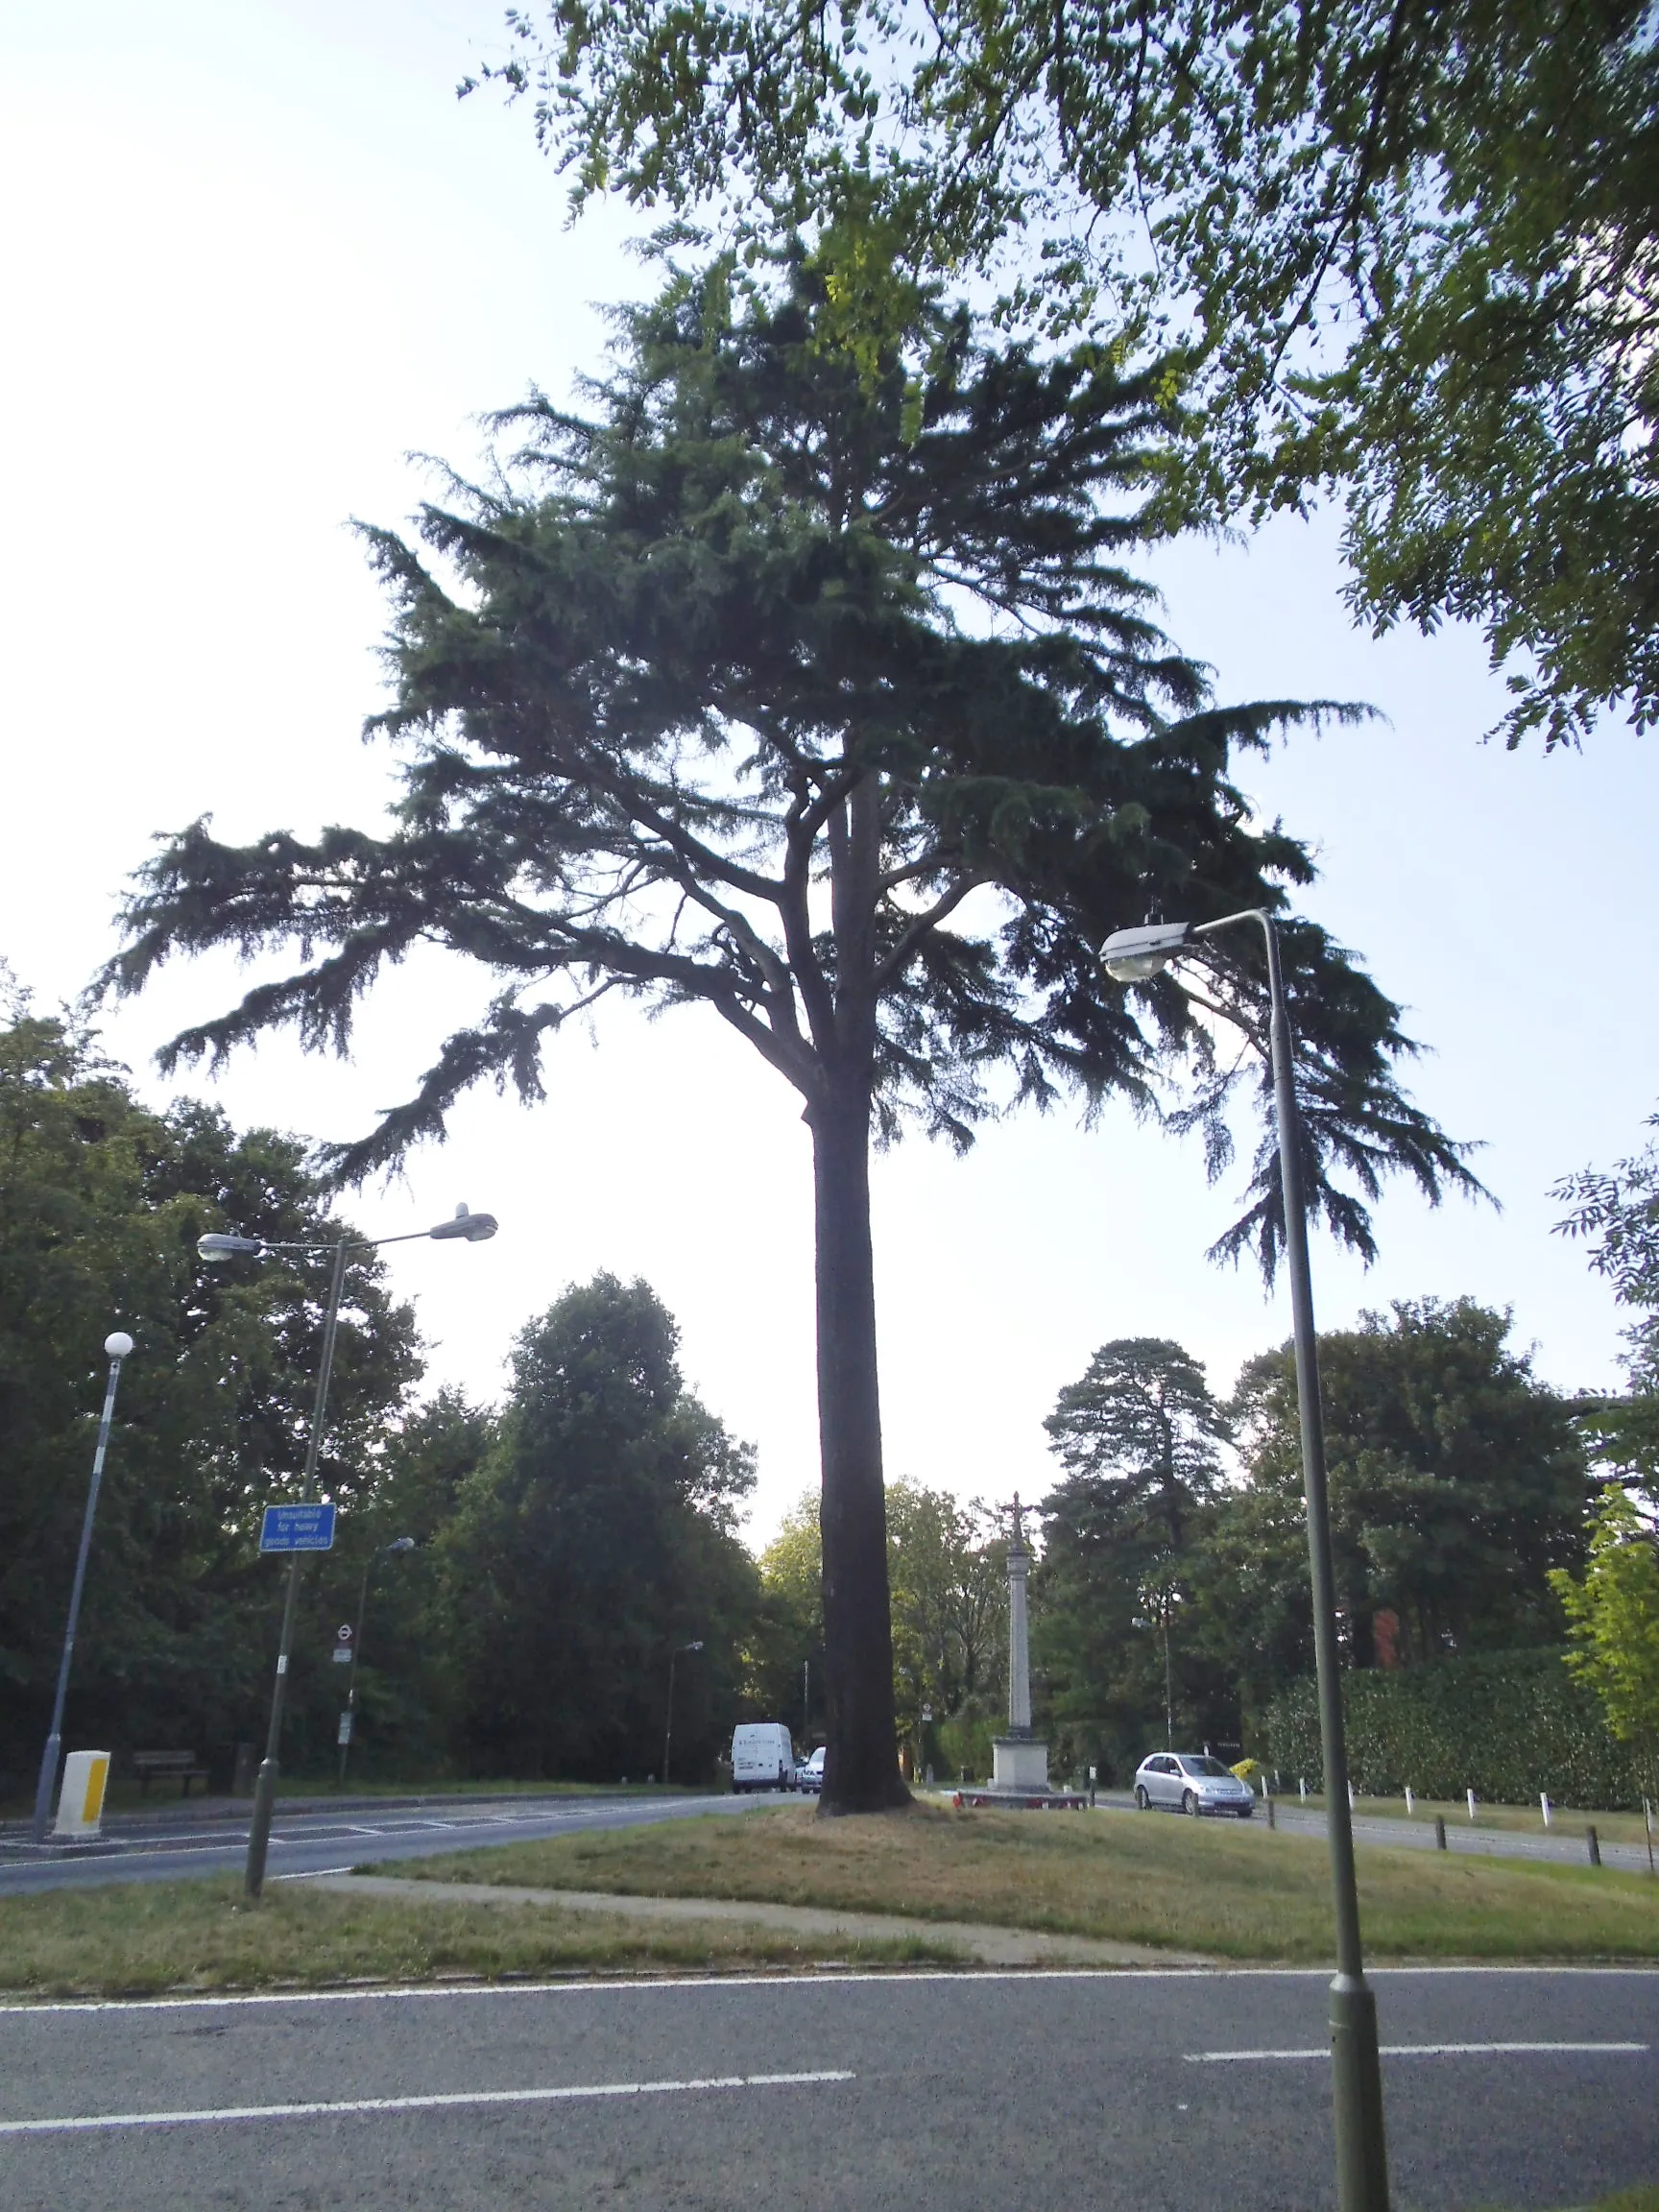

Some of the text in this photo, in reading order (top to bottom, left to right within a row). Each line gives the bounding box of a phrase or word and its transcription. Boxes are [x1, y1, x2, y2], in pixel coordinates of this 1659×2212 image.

[277, 1508, 322, 1520] Unsuitable
[277, 1522, 319, 1532] for heavy
[264, 1536, 328, 1548] goods vehicles
